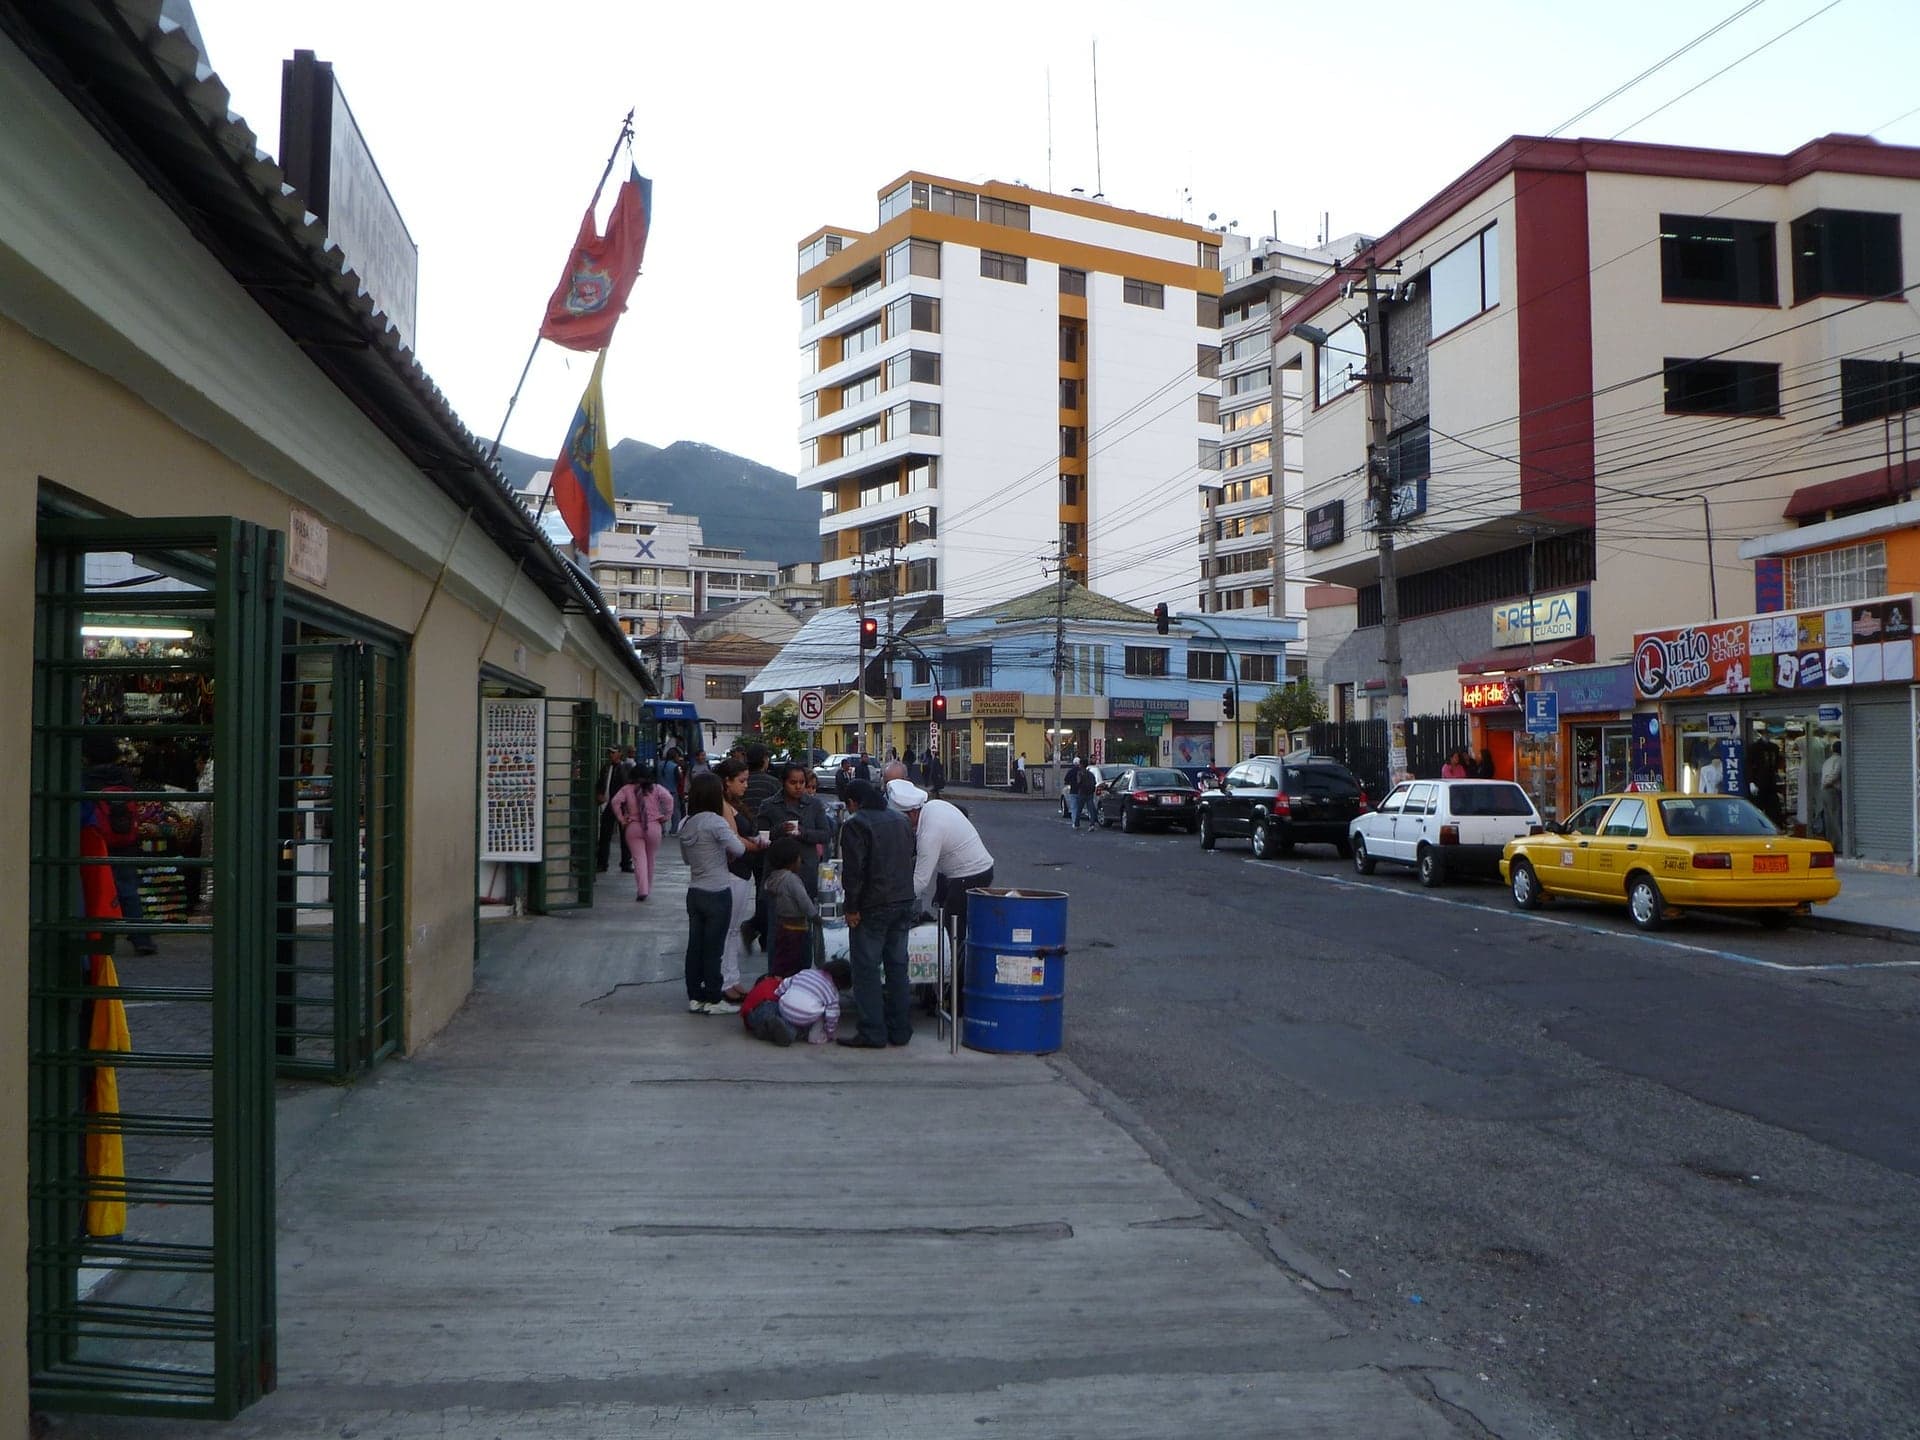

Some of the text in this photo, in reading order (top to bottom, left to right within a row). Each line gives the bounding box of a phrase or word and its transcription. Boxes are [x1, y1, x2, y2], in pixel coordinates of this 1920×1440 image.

[1712, 626, 1744, 650] SHOP
[1635, 628, 1708, 696] Quito
[1713, 643, 1745, 662] CENTER
[1537, 701, 1547, 717] E
